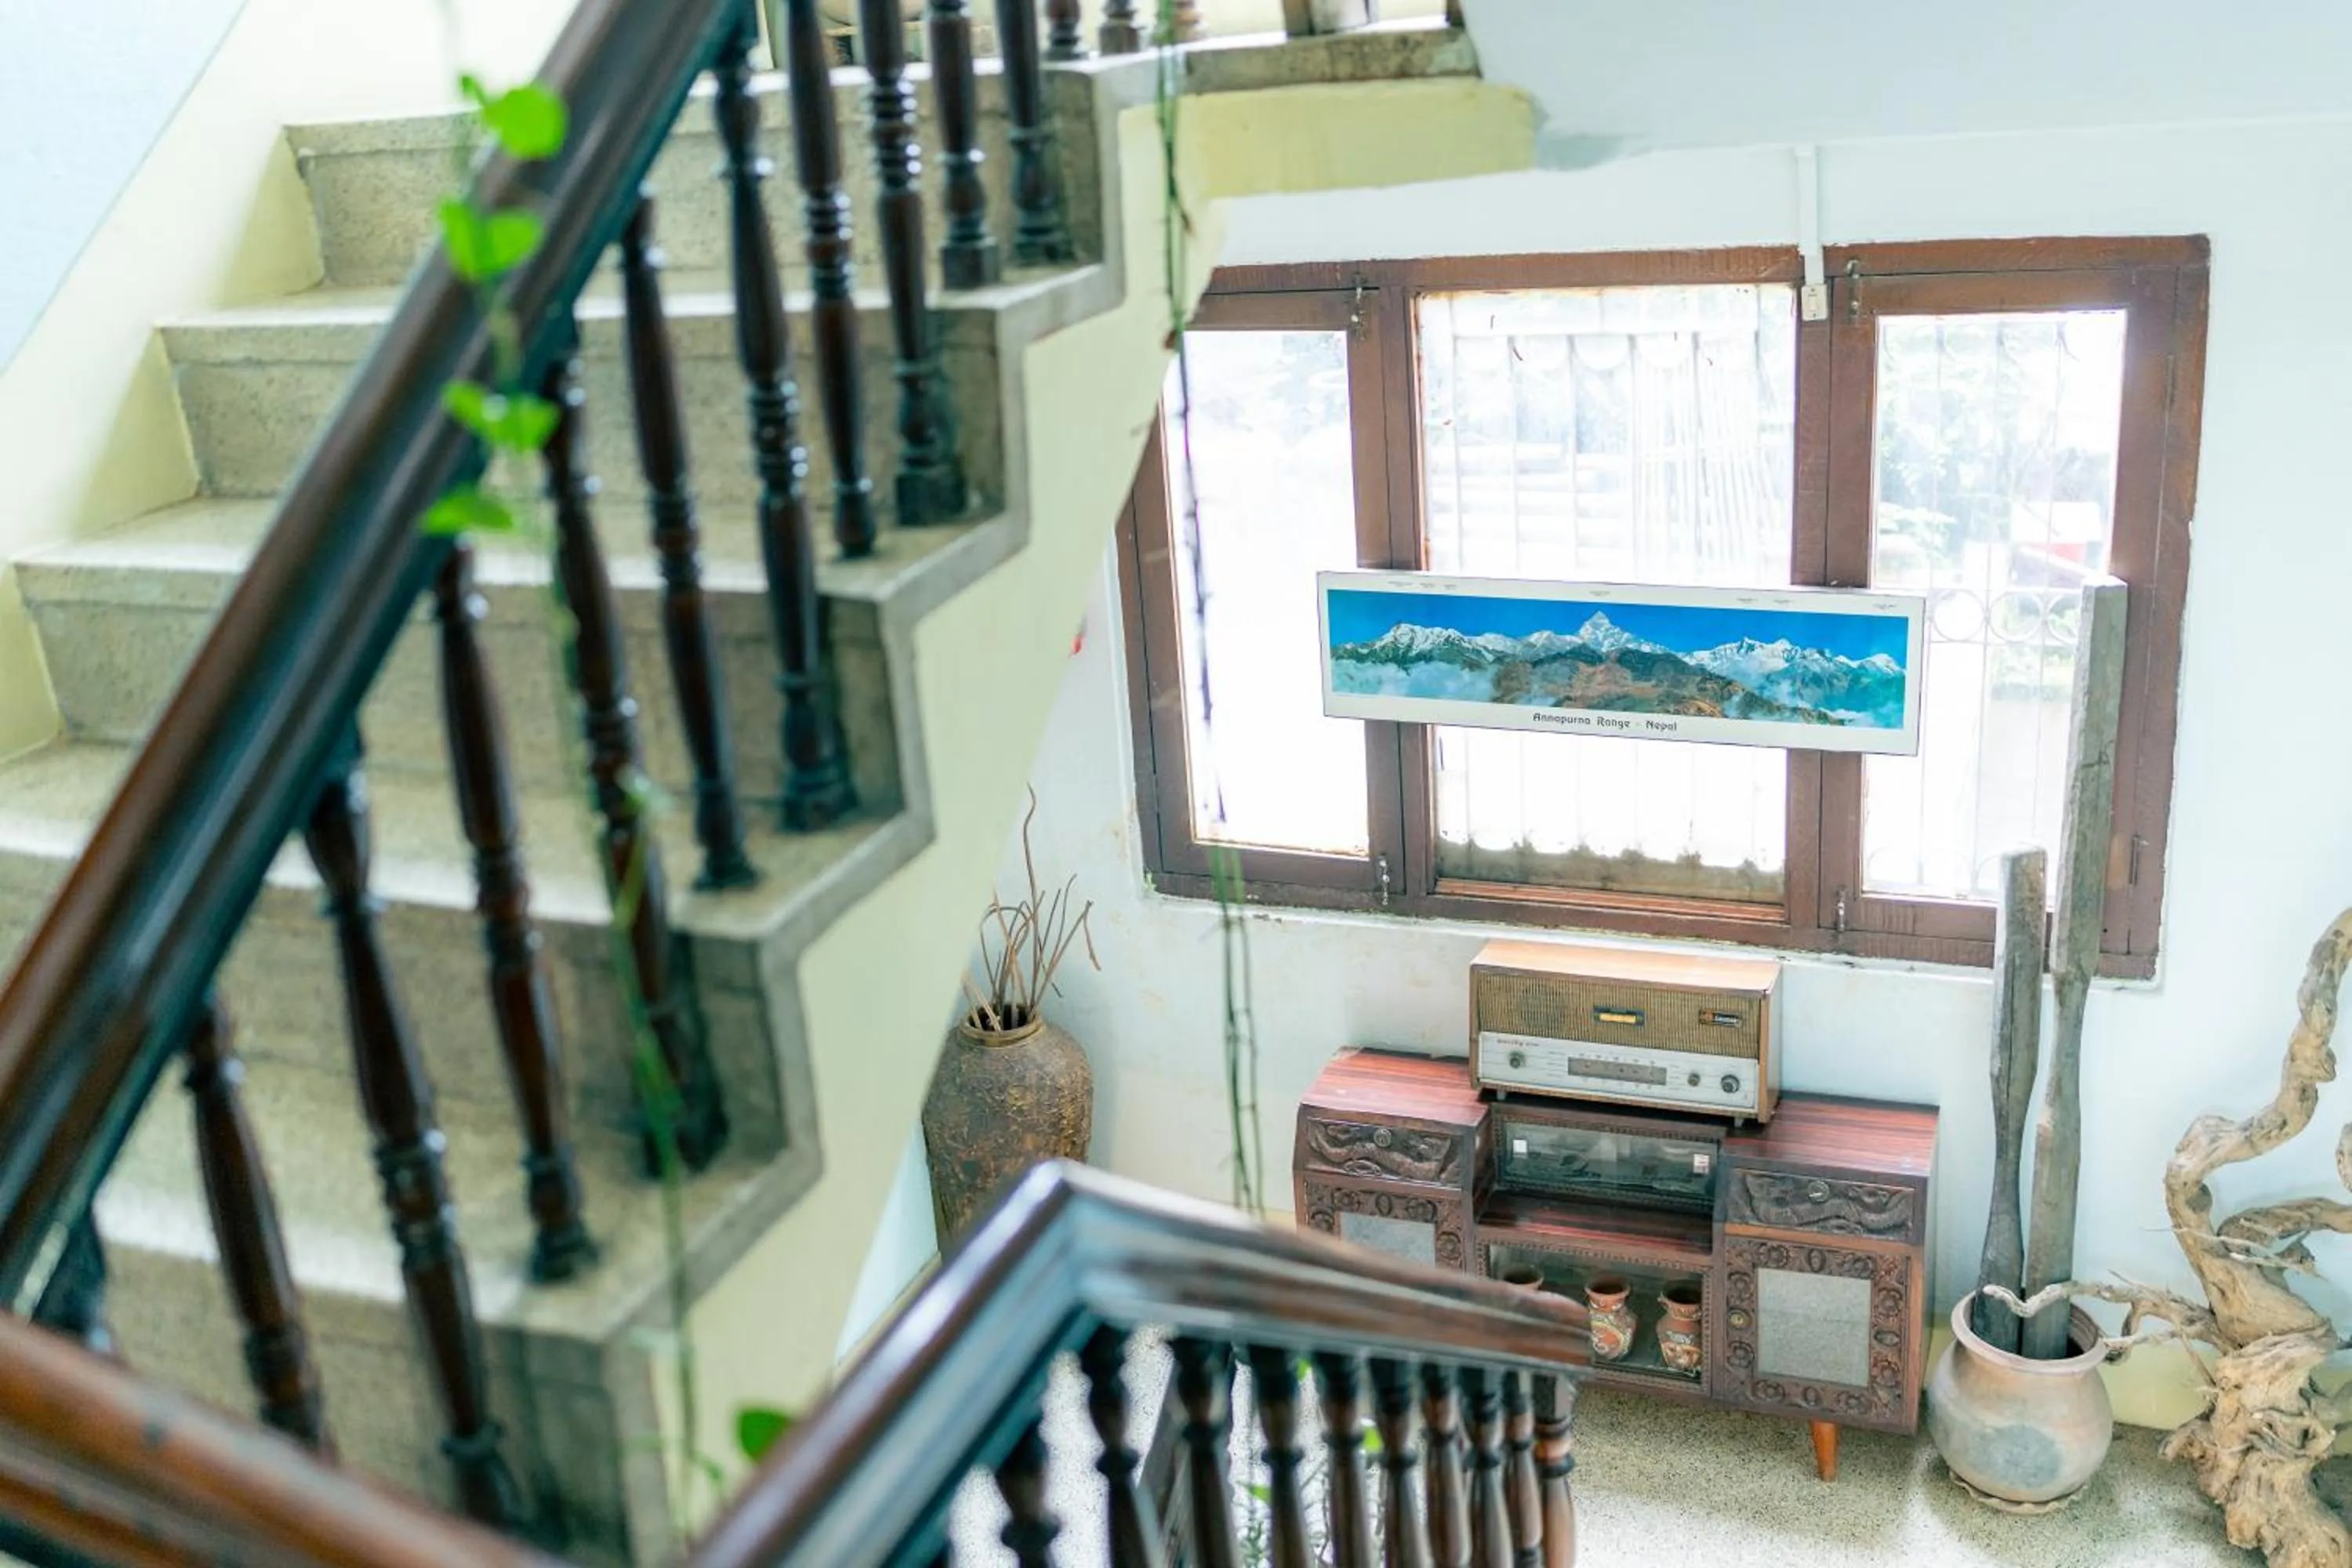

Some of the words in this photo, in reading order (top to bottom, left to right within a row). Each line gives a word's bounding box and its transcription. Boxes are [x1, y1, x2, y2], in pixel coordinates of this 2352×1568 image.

[1533, 712, 1591, 725] Annapurna
[1597, 716, 1631, 729] Range
[1646, 720, 1677, 732] Nepal
